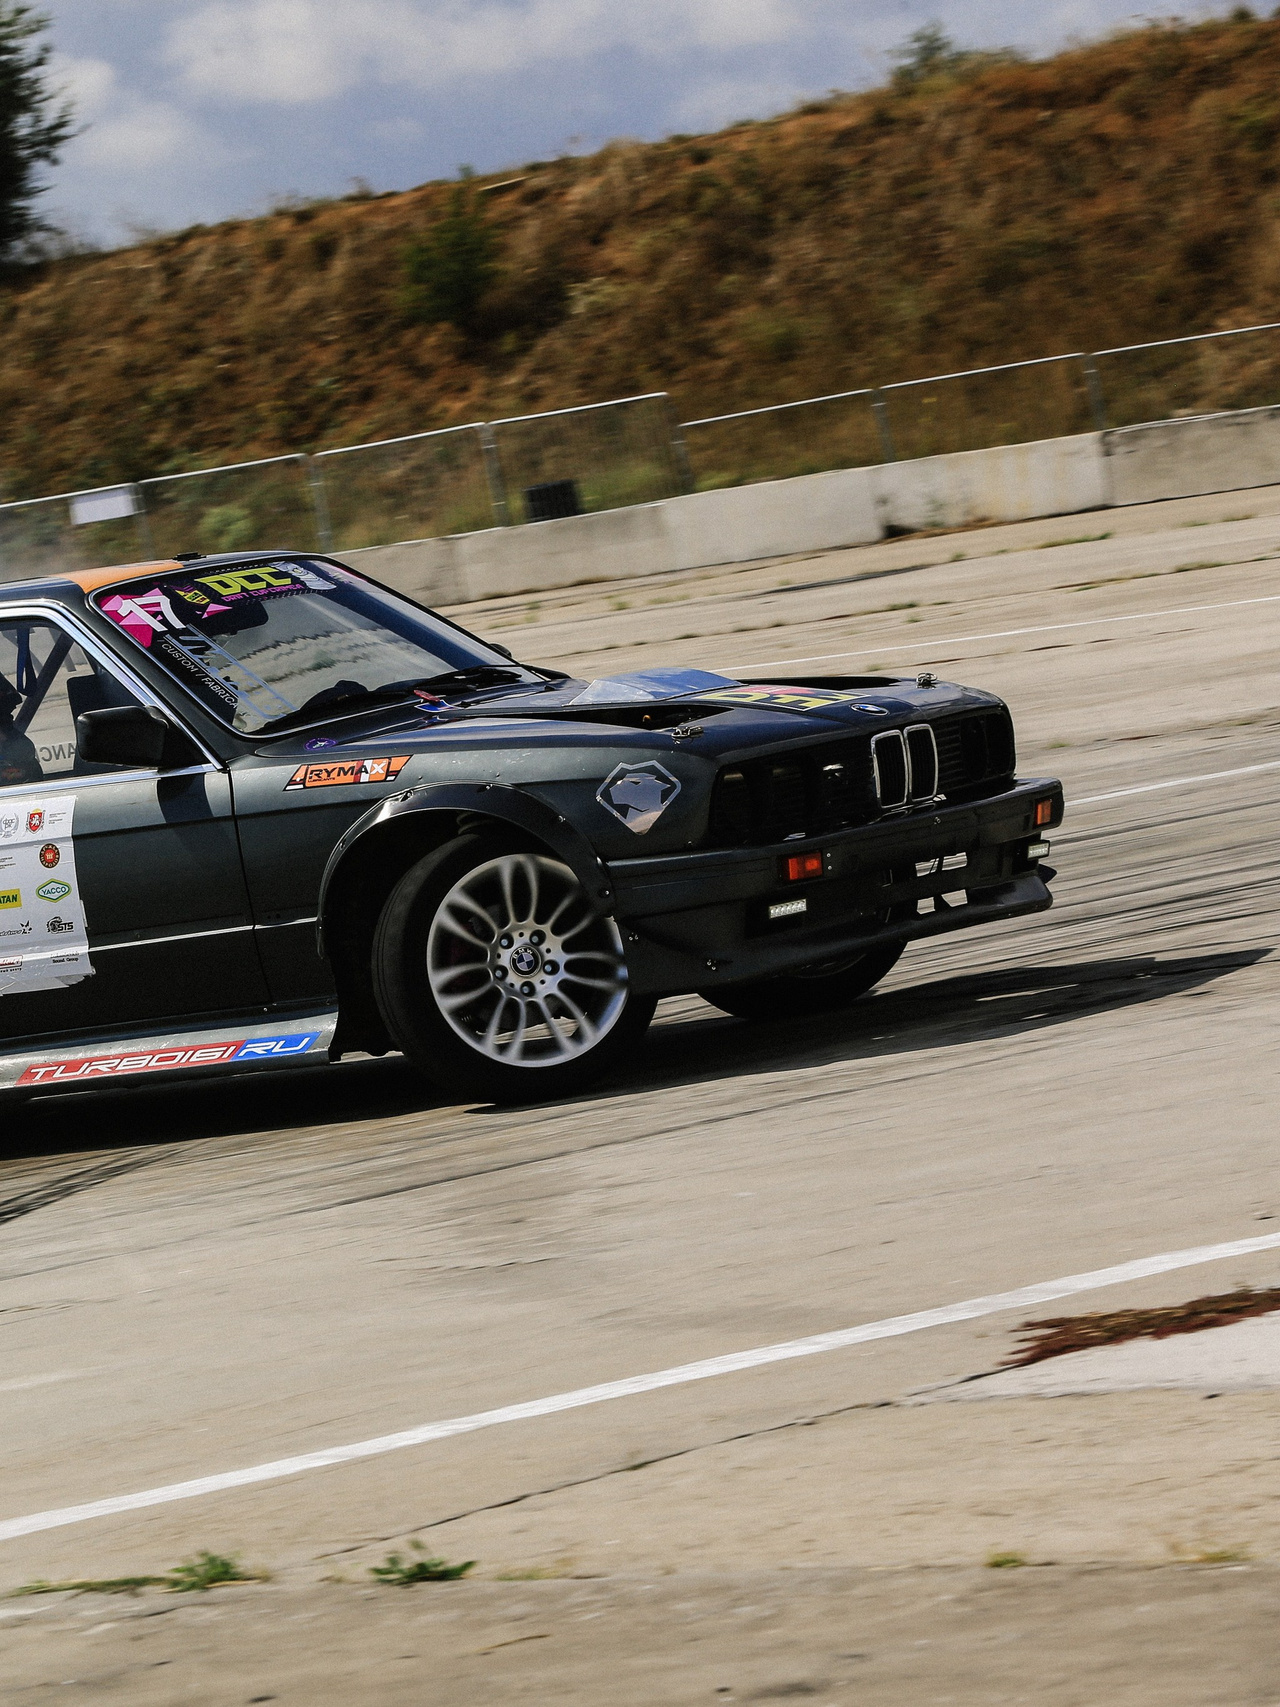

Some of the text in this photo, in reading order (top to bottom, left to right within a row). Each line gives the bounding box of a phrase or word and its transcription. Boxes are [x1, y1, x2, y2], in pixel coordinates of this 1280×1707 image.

[194, 566, 291, 596] DCC
[117, 595, 187, 632] 17
[161, 643, 198, 673] CUSTOM
[308, 762, 385, 779] RYMAX
[41, 886, 67, 896] YACCO
[57, 921, 74, 932] STS
[512, 948, 533, 959] BMW
